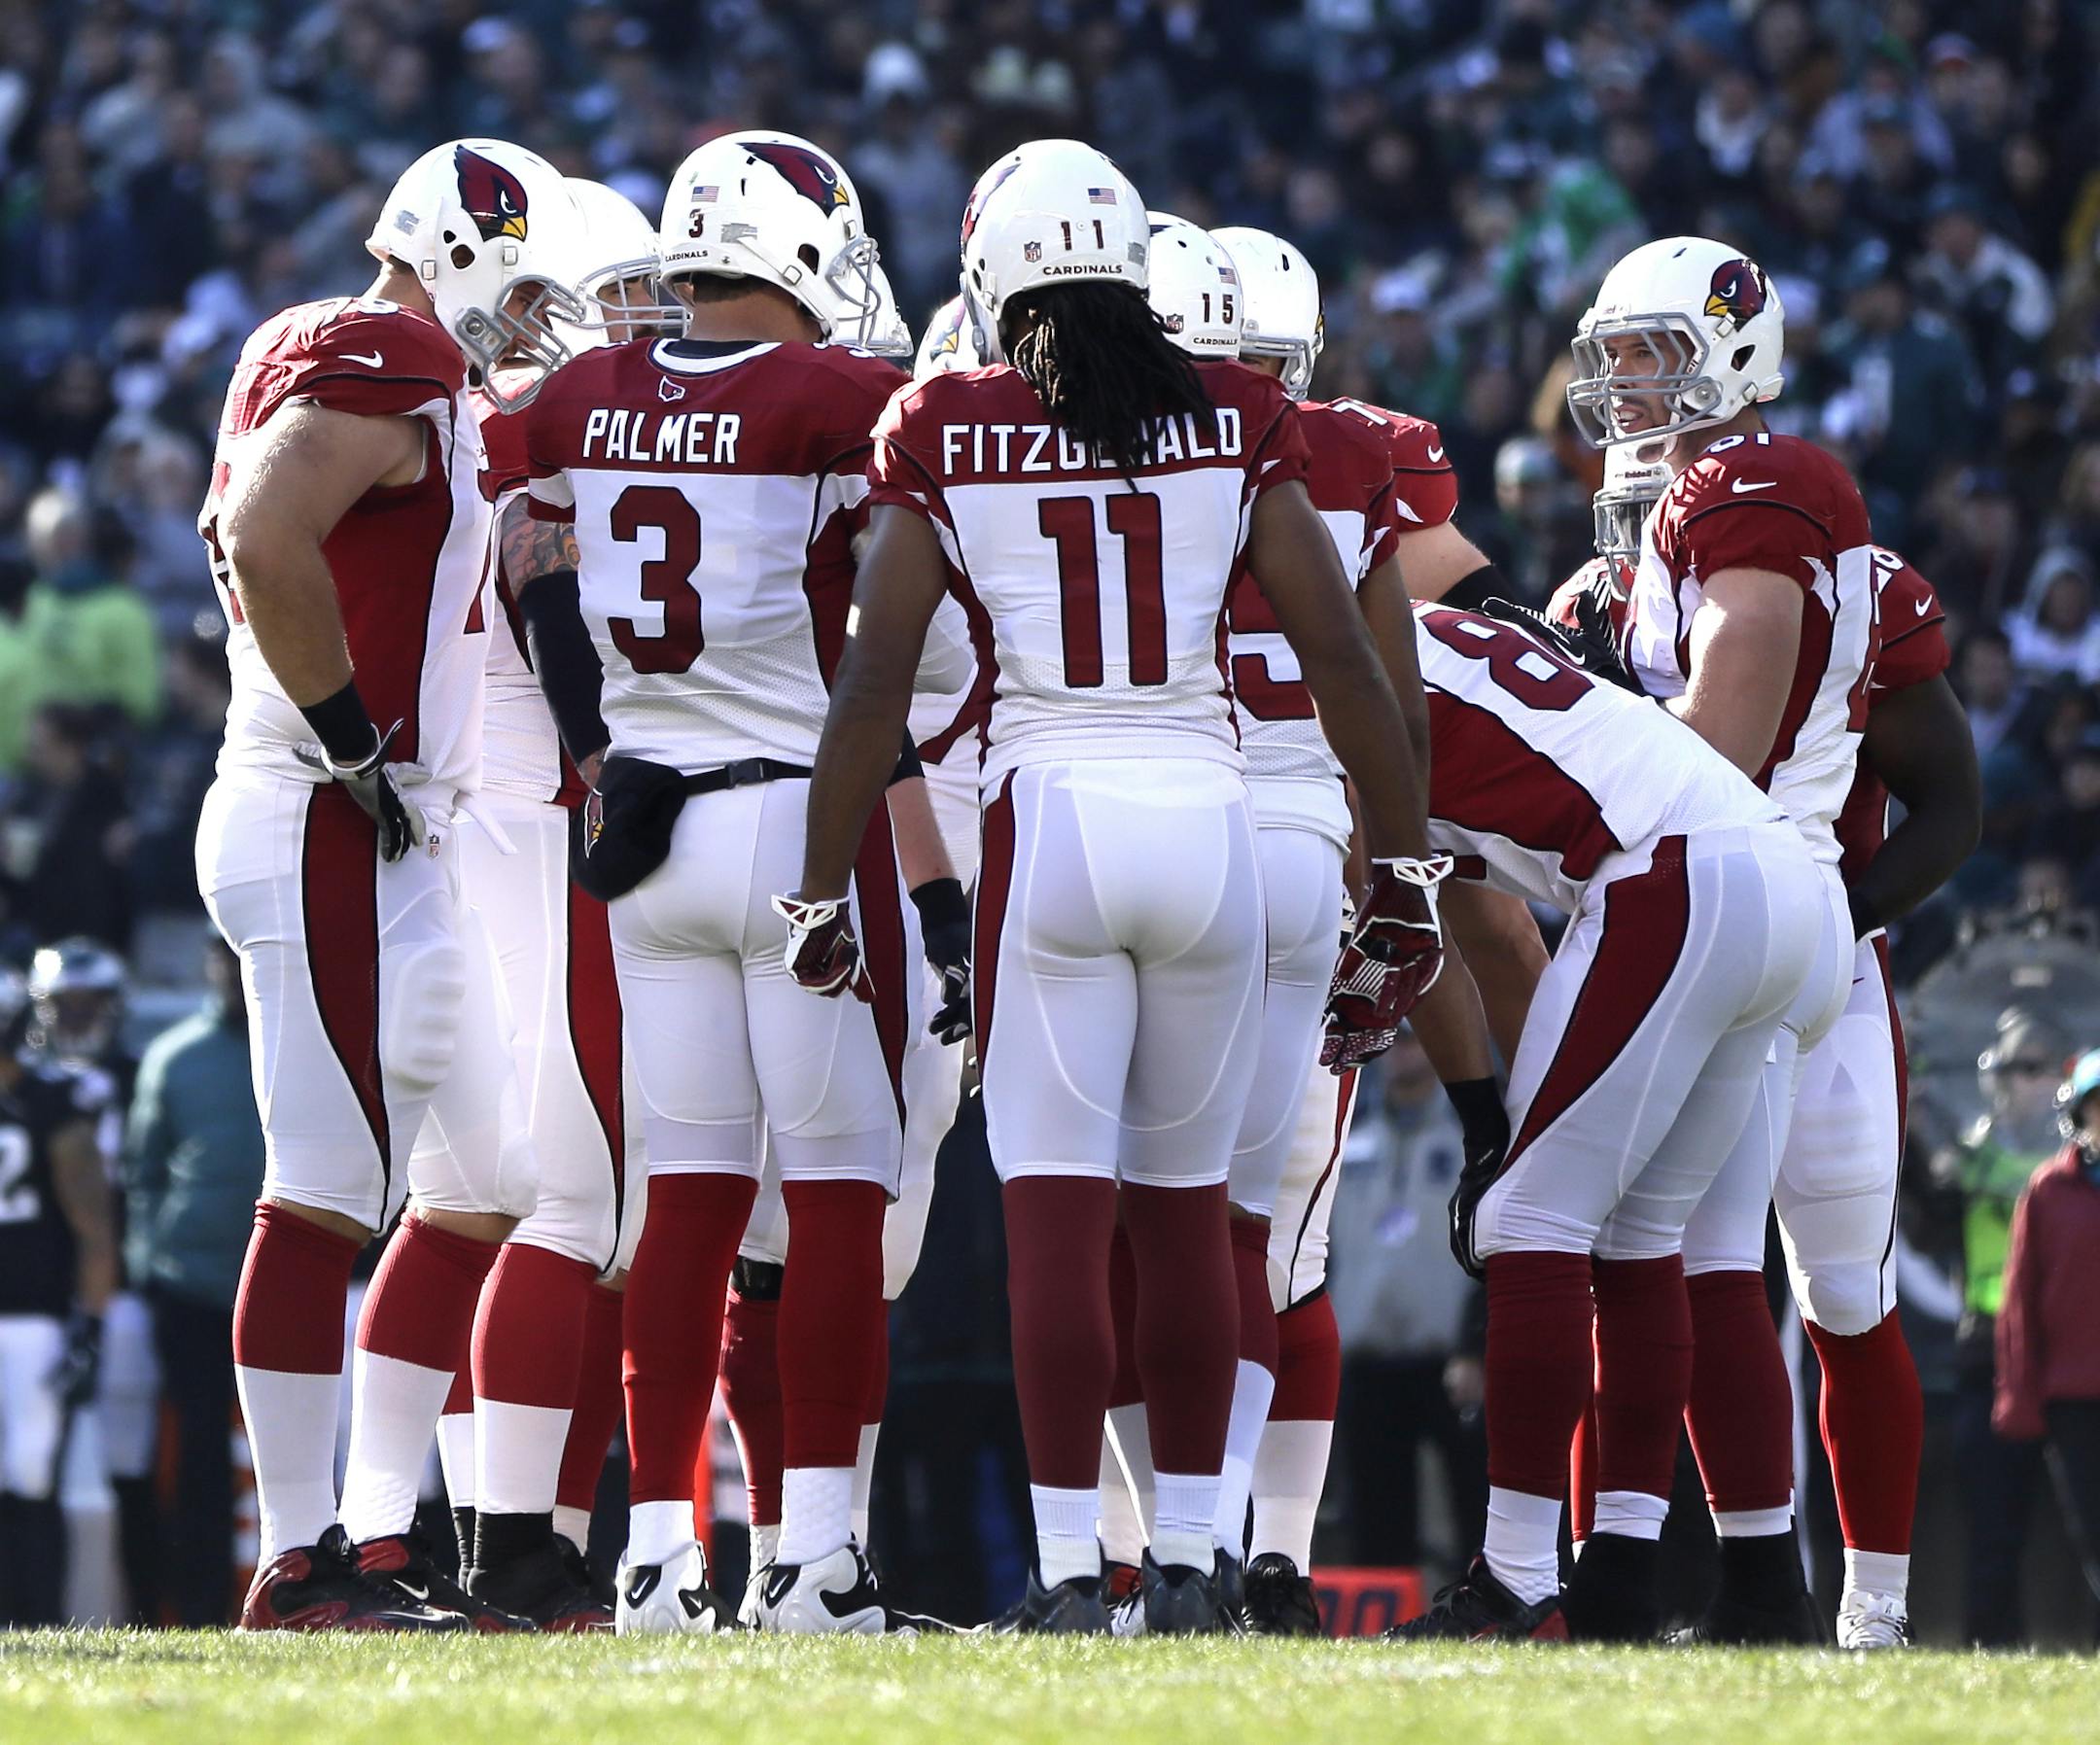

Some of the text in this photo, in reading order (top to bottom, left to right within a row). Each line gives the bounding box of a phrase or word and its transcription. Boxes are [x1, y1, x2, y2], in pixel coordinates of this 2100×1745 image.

[688, 208, 705, 238] 3
[665, 250, 709, 262] CARDINALS
[1043, 264, 1123, 275] CARDINALS
[1202, 293, 1234, 325] 15
[1193, 336, 1238, 345] CARDINALS
[583, 408, 741, 464] PALMER
[607, 484, 705, 674] 3
[1037, 492, 1169, 688] 11
